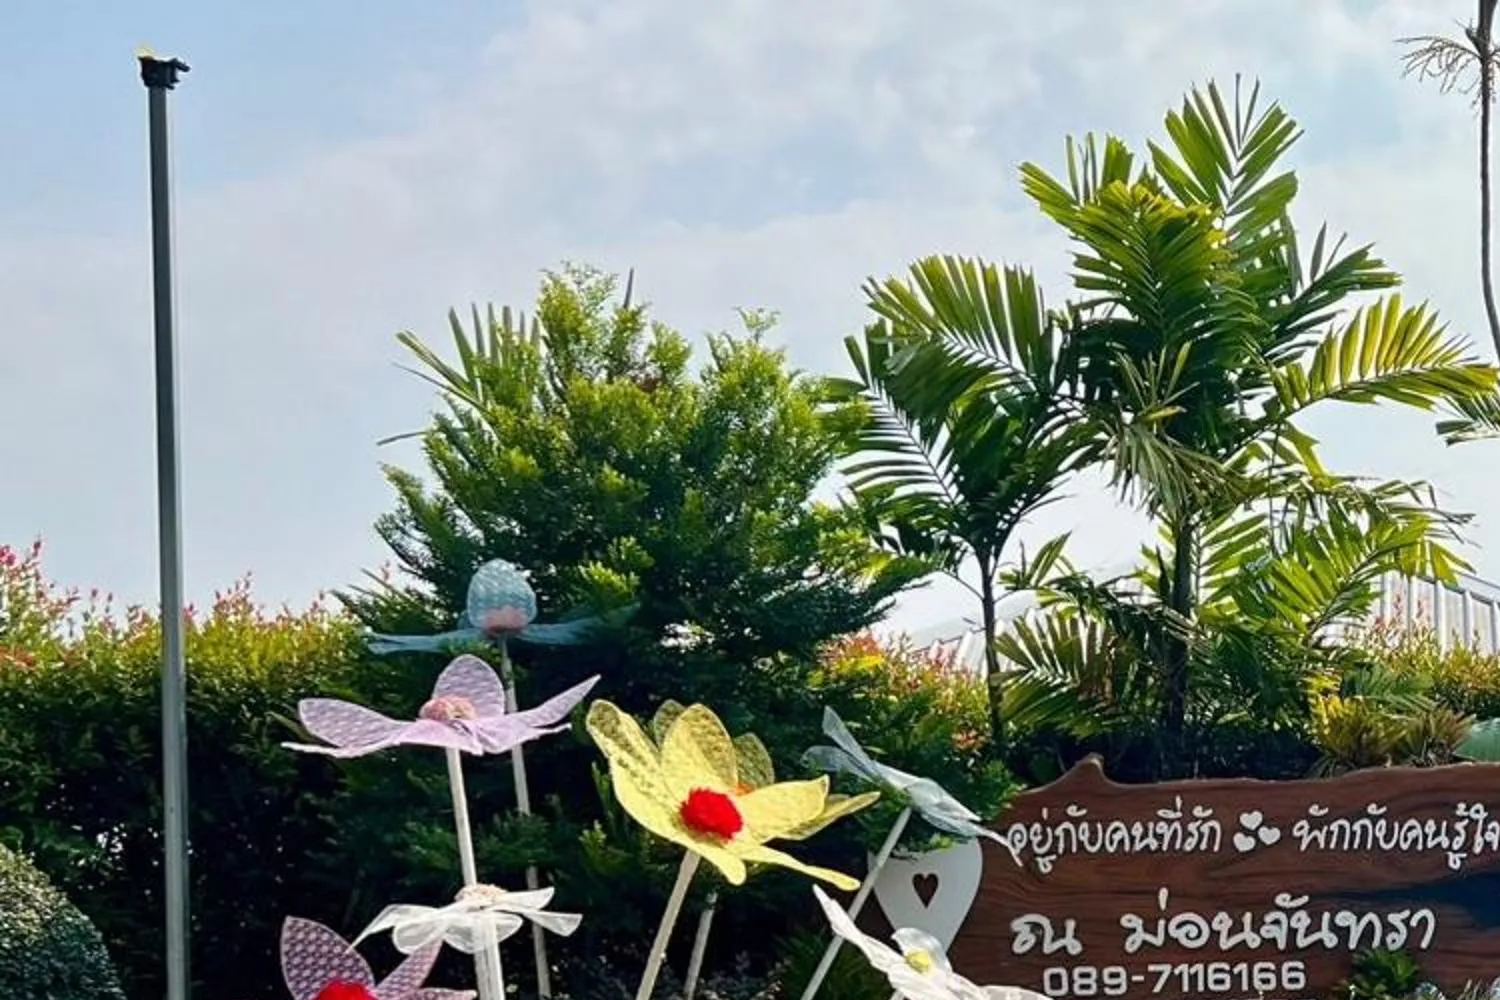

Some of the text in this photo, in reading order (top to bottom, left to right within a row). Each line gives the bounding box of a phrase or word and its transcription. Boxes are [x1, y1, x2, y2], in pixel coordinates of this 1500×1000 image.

[1007, 795, 1500, 873] อยู่กับคนที่รัก พักกับคนรู้ใจ
[1010, 887, 1436, 956] ณ ม่อนจันทรา
[1043, 960, 1306, 997] 089-7116166
